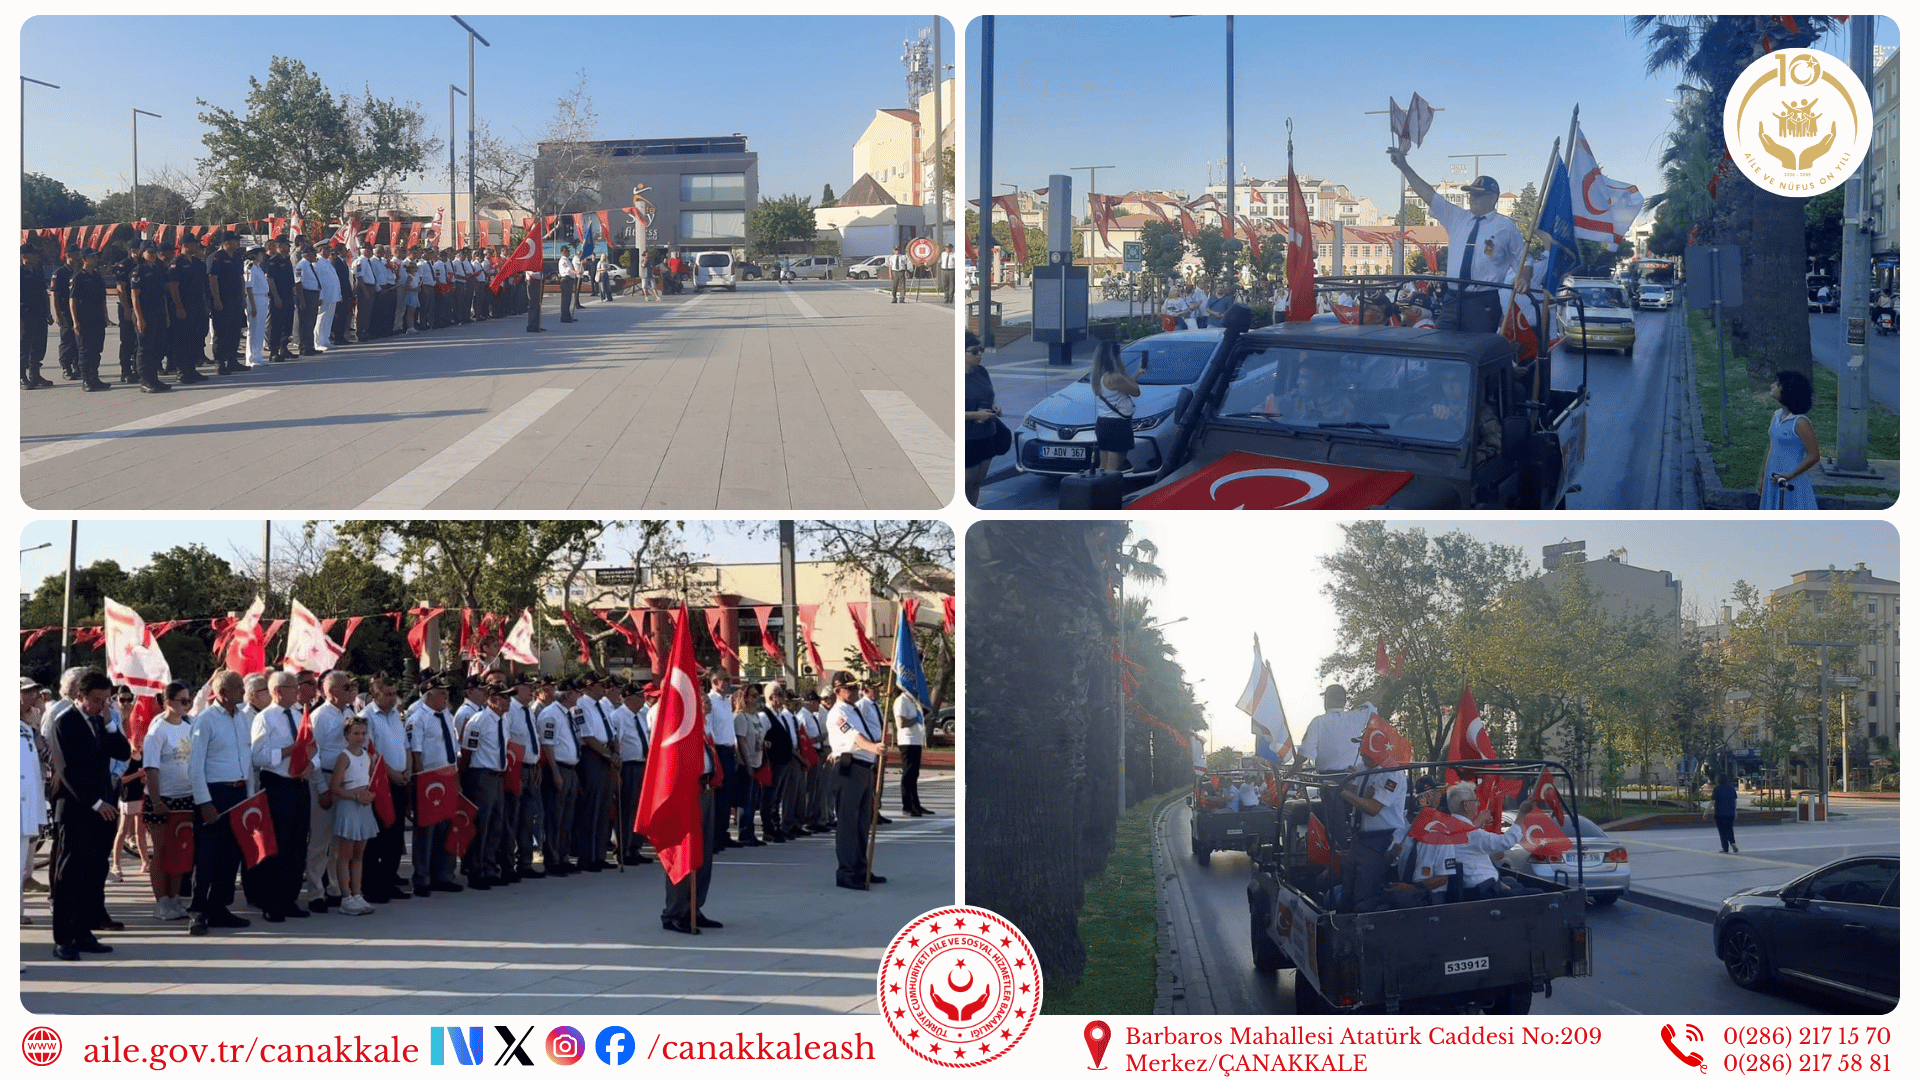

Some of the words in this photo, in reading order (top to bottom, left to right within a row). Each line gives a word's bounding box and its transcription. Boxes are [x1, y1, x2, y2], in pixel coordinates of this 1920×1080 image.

[1043, 447, 1050, 456] 17
[1072, 448, 1084, 457] 367
[1447, 959, 1487, 972] 533912
